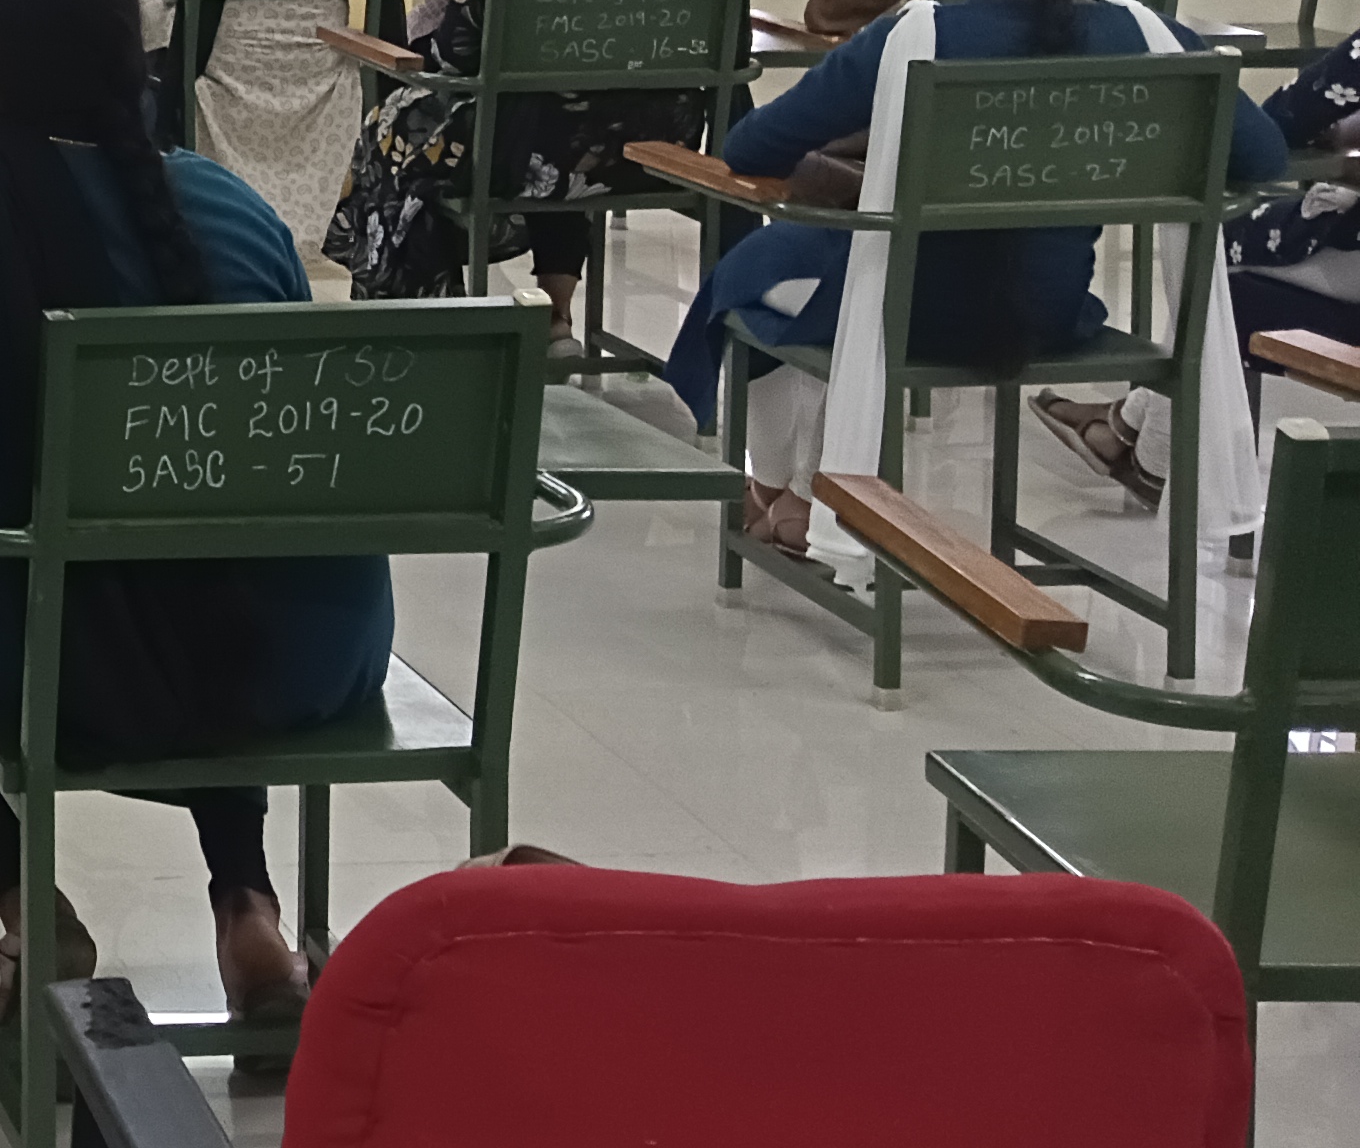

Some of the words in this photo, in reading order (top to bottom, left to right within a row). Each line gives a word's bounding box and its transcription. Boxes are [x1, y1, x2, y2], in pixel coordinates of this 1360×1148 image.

[536, 15, 584, 35] FMC
[540, 38, 617, 63] SASC
[1090, 84, 1149, 106] TSD
[969, 125, 1028, 151] FMC
[969, 164, 1059, 188] SASC
[1086, 158, 1128, 182] 27
[128, 346, 219, 390] Dept
[238, 347, 283, 394] of
[304, 345, 416, 388] TSD
[124, 402, 218, 441] FMC
[247, 396, 425, 438] 2019-20
[122, 449, 227, 493] SASC
